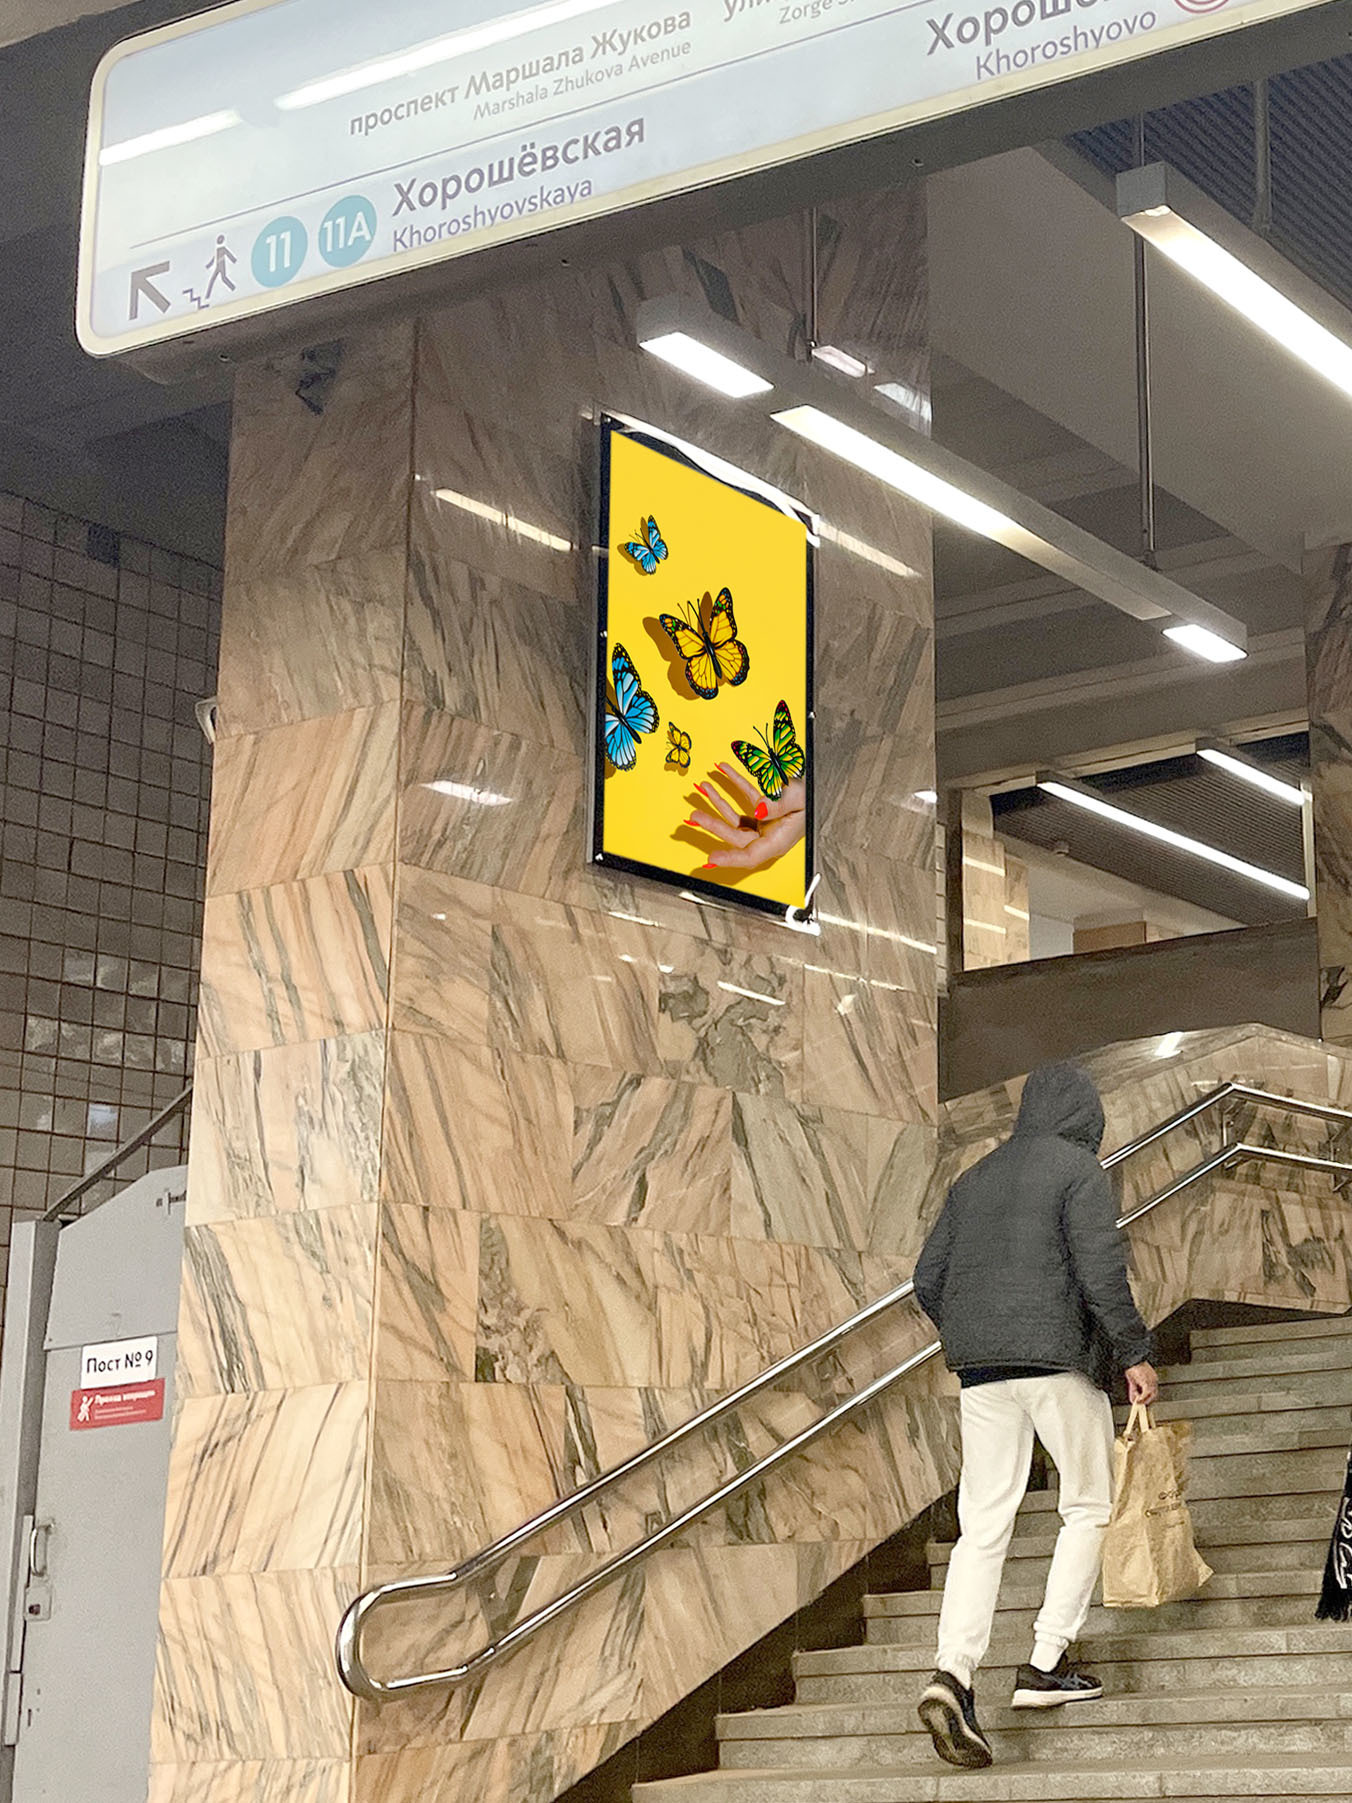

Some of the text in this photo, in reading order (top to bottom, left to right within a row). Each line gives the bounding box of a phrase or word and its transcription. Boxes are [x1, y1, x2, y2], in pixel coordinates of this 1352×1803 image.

[779, 0, 833, 24] Zorge
[976, 10, 1156, 80] Khoroshyovo
[350, 10, 692, 136] проспект Маршала Жукова
[473, 41, 692, 121] Marshala Zhukova Avenue
[265, 231, 292, 273] 11
[392, 118, 645, 217] Хорошёвская
[393, 177, 593, 252] Khoroshyovskaya
[86, 1357, 121, 1373] Пост
